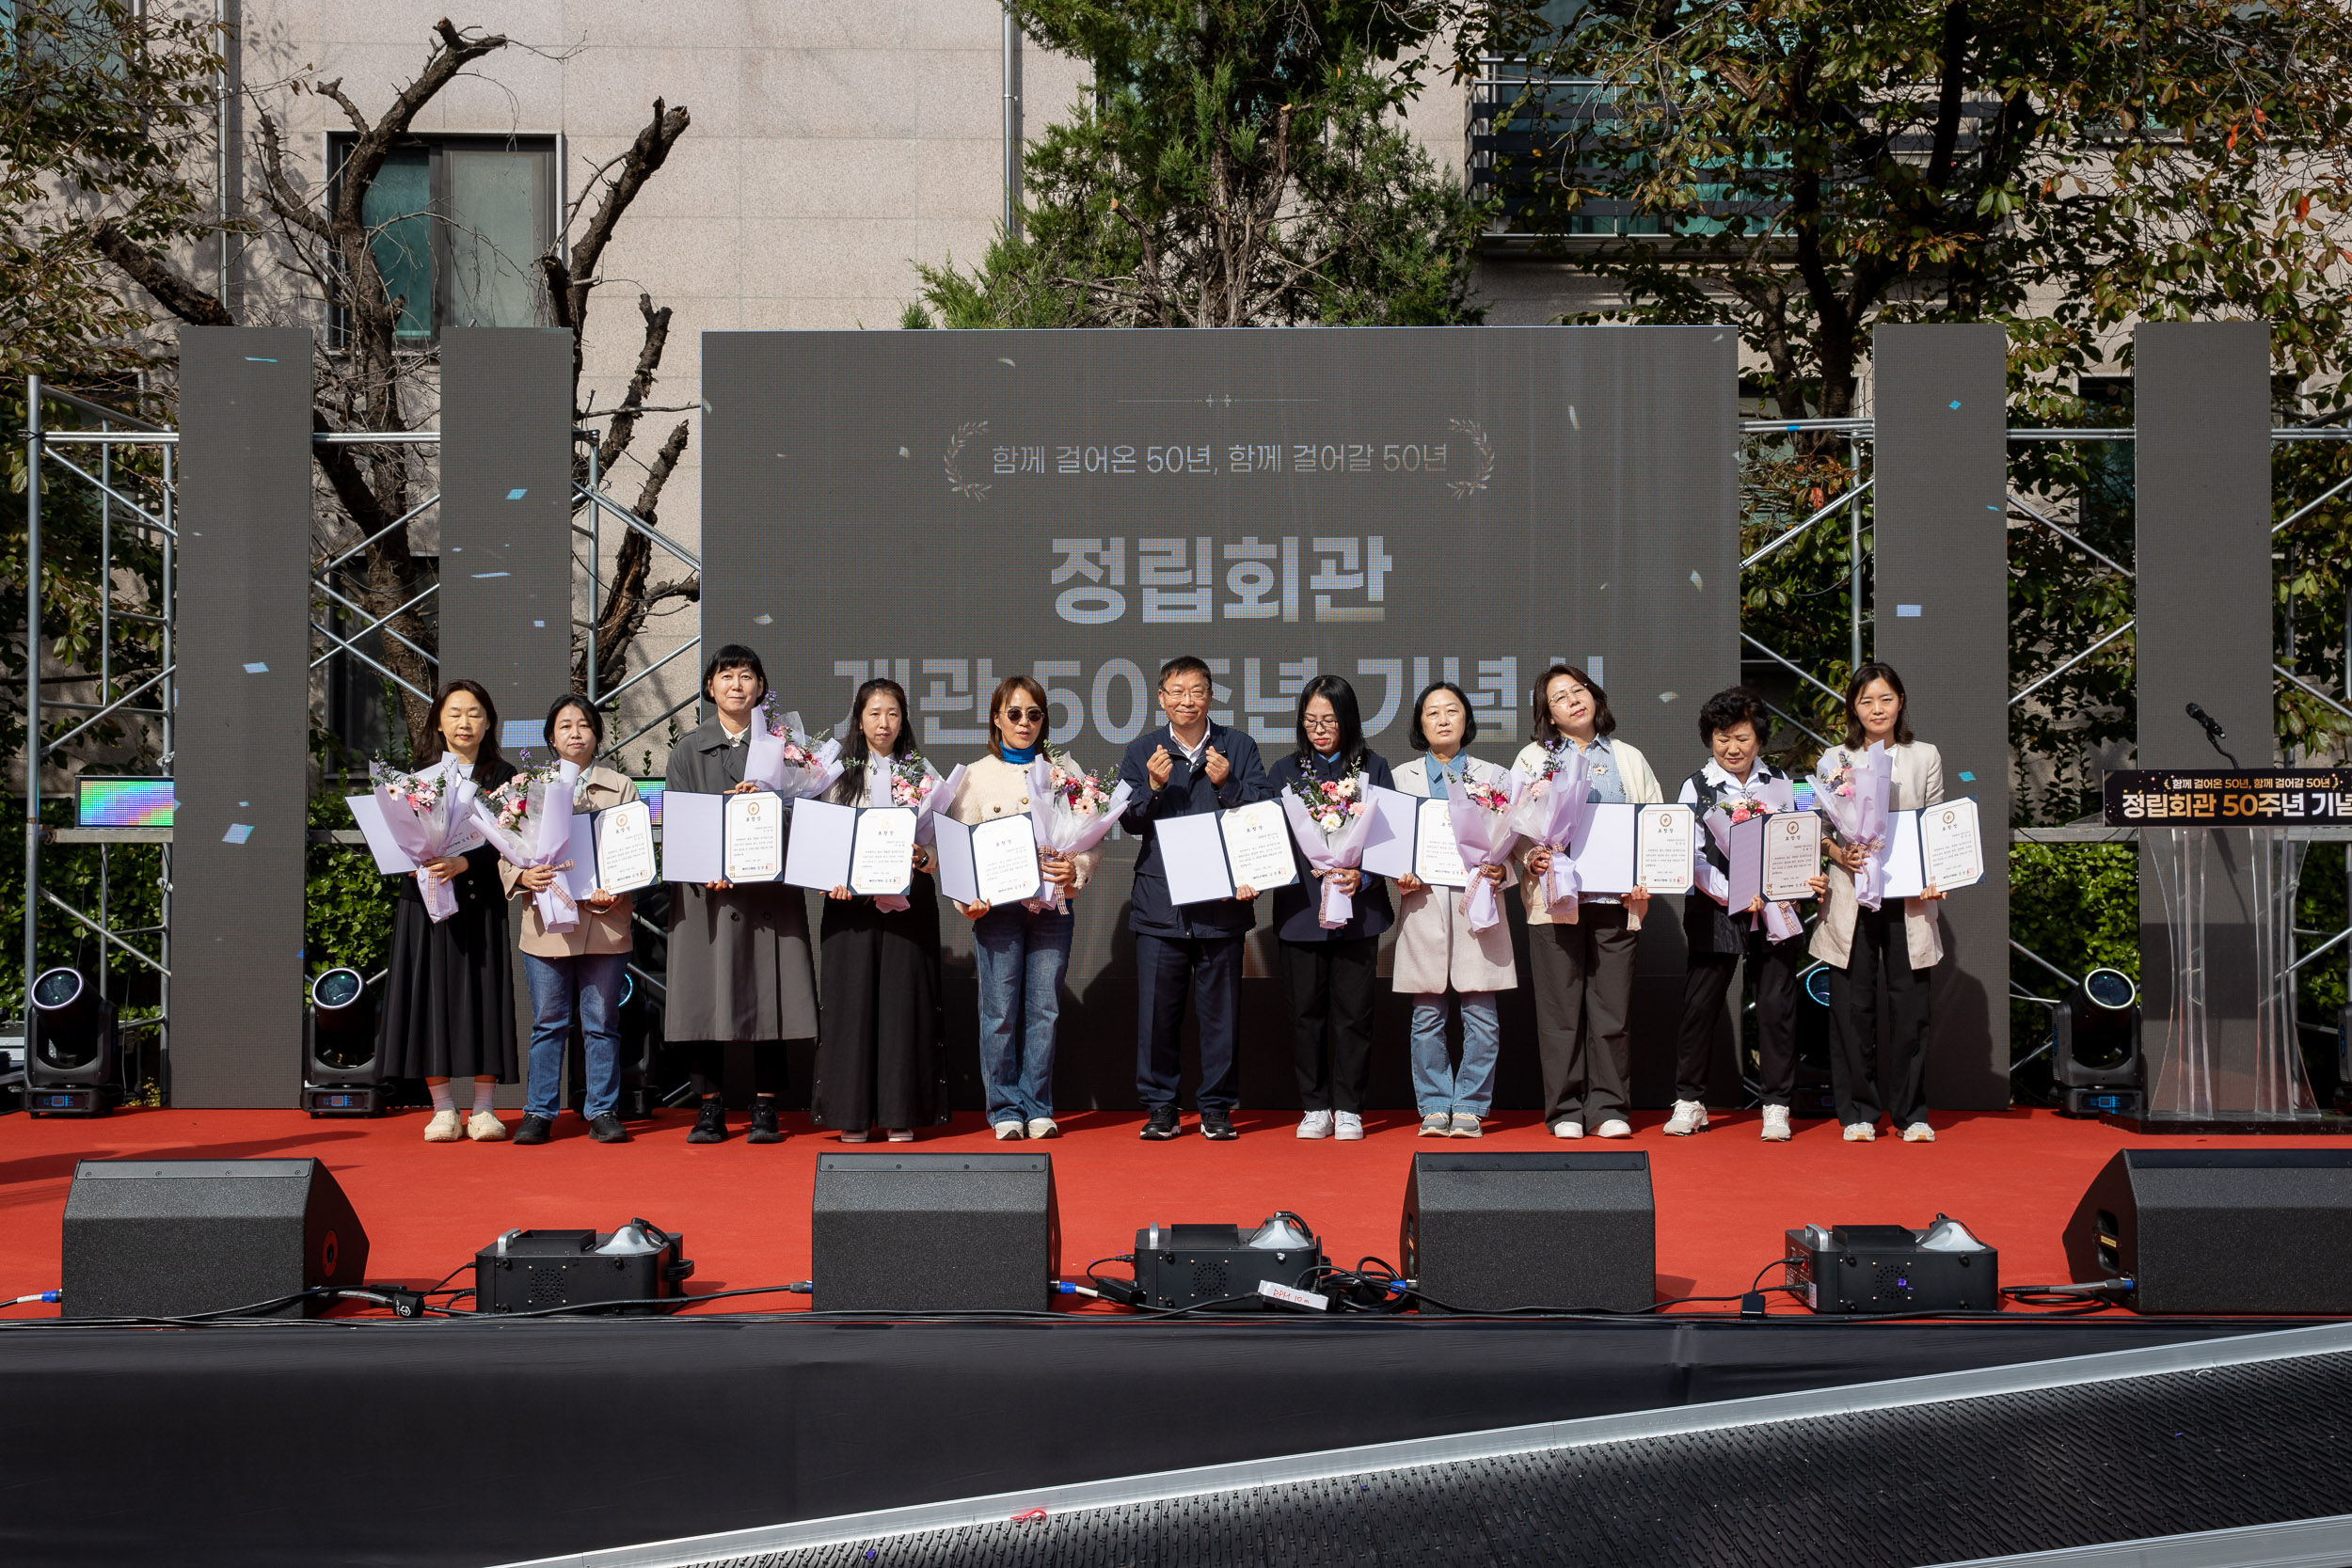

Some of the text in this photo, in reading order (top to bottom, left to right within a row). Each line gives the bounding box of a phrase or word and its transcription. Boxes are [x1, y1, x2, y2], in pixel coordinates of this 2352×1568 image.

[993, 444, 1447, 475] 함께 걸어온 50년, 함께 걸어갈 50년
[1051, 536, 1393, 625] 정립회관
[2172, 777, 2330, 790] 함께 걸어온 50년, 함께 걸어갈 50년
[2122, 793, 2217, 818] 정립회관
[2222, 793, 2305, 817] 50주년
